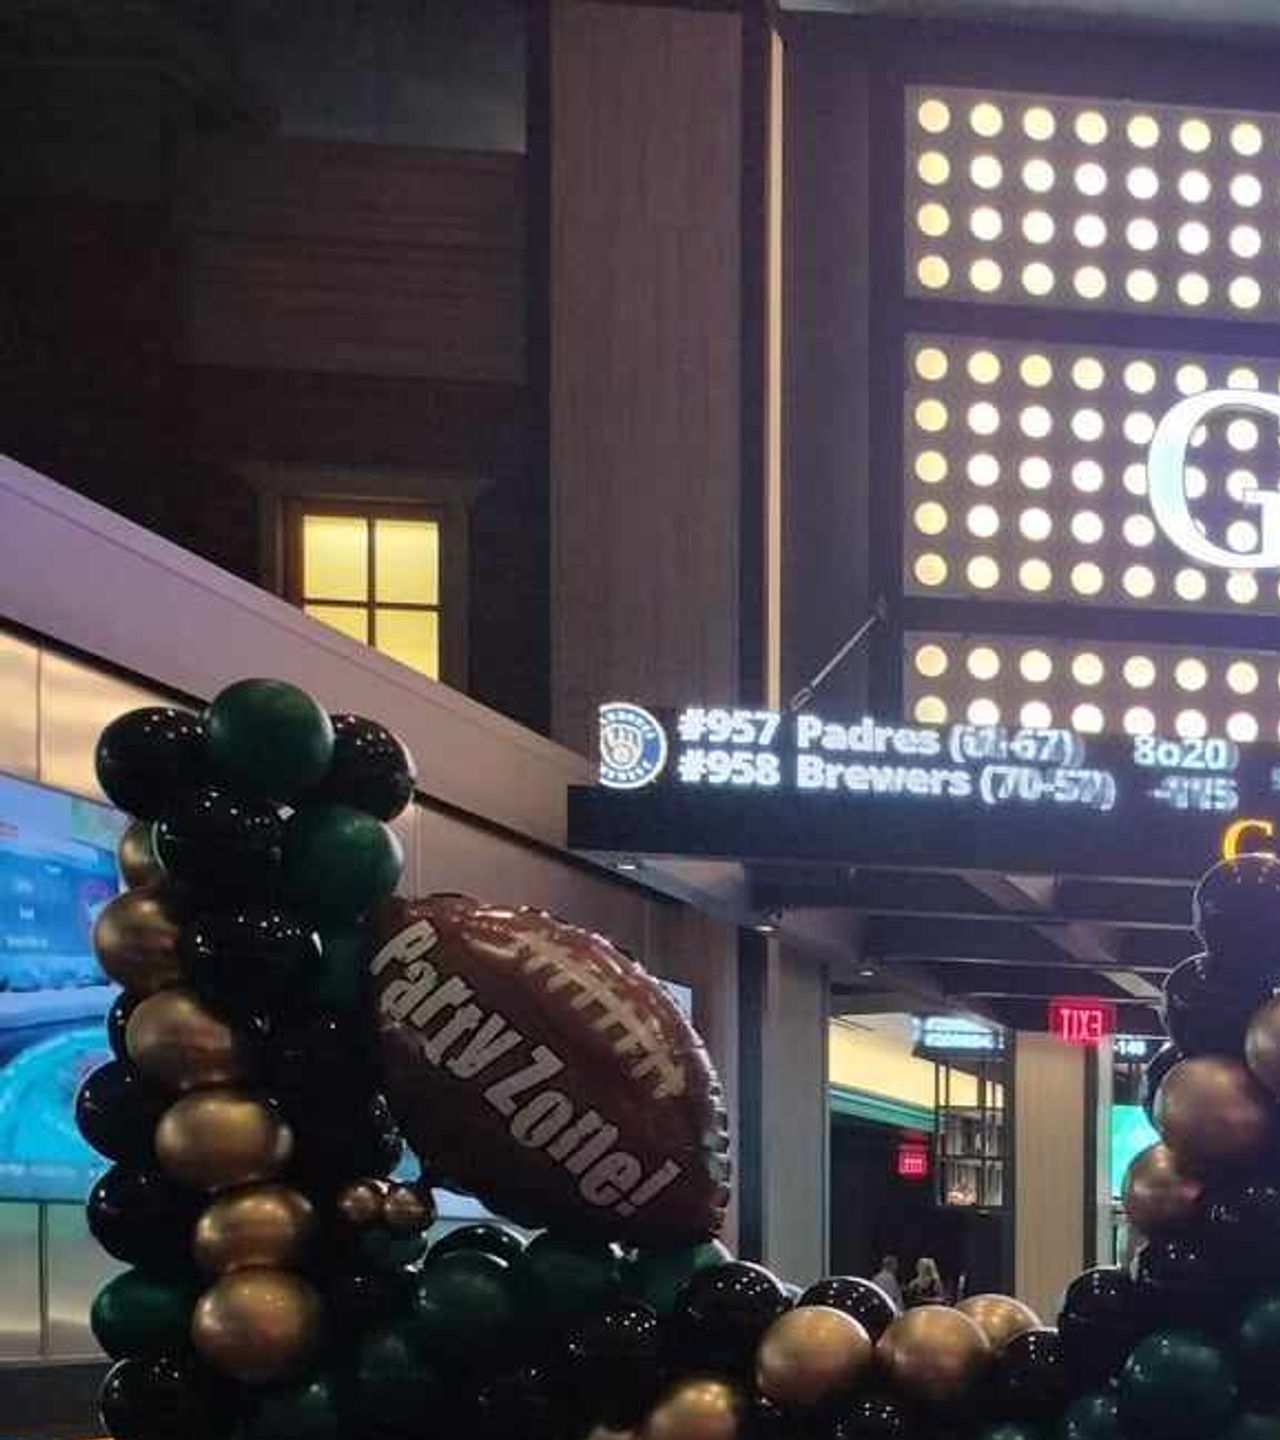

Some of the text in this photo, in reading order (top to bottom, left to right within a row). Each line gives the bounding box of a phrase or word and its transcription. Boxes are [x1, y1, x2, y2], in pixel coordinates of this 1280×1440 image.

[678, 706, 781, 745] #957
[797, 714, 941, 755] Padres
[678, 747, 781, 785] #958
[797, 753, 972, 797] Brewers
[369, 920, 683, 1218] Party Zone!
